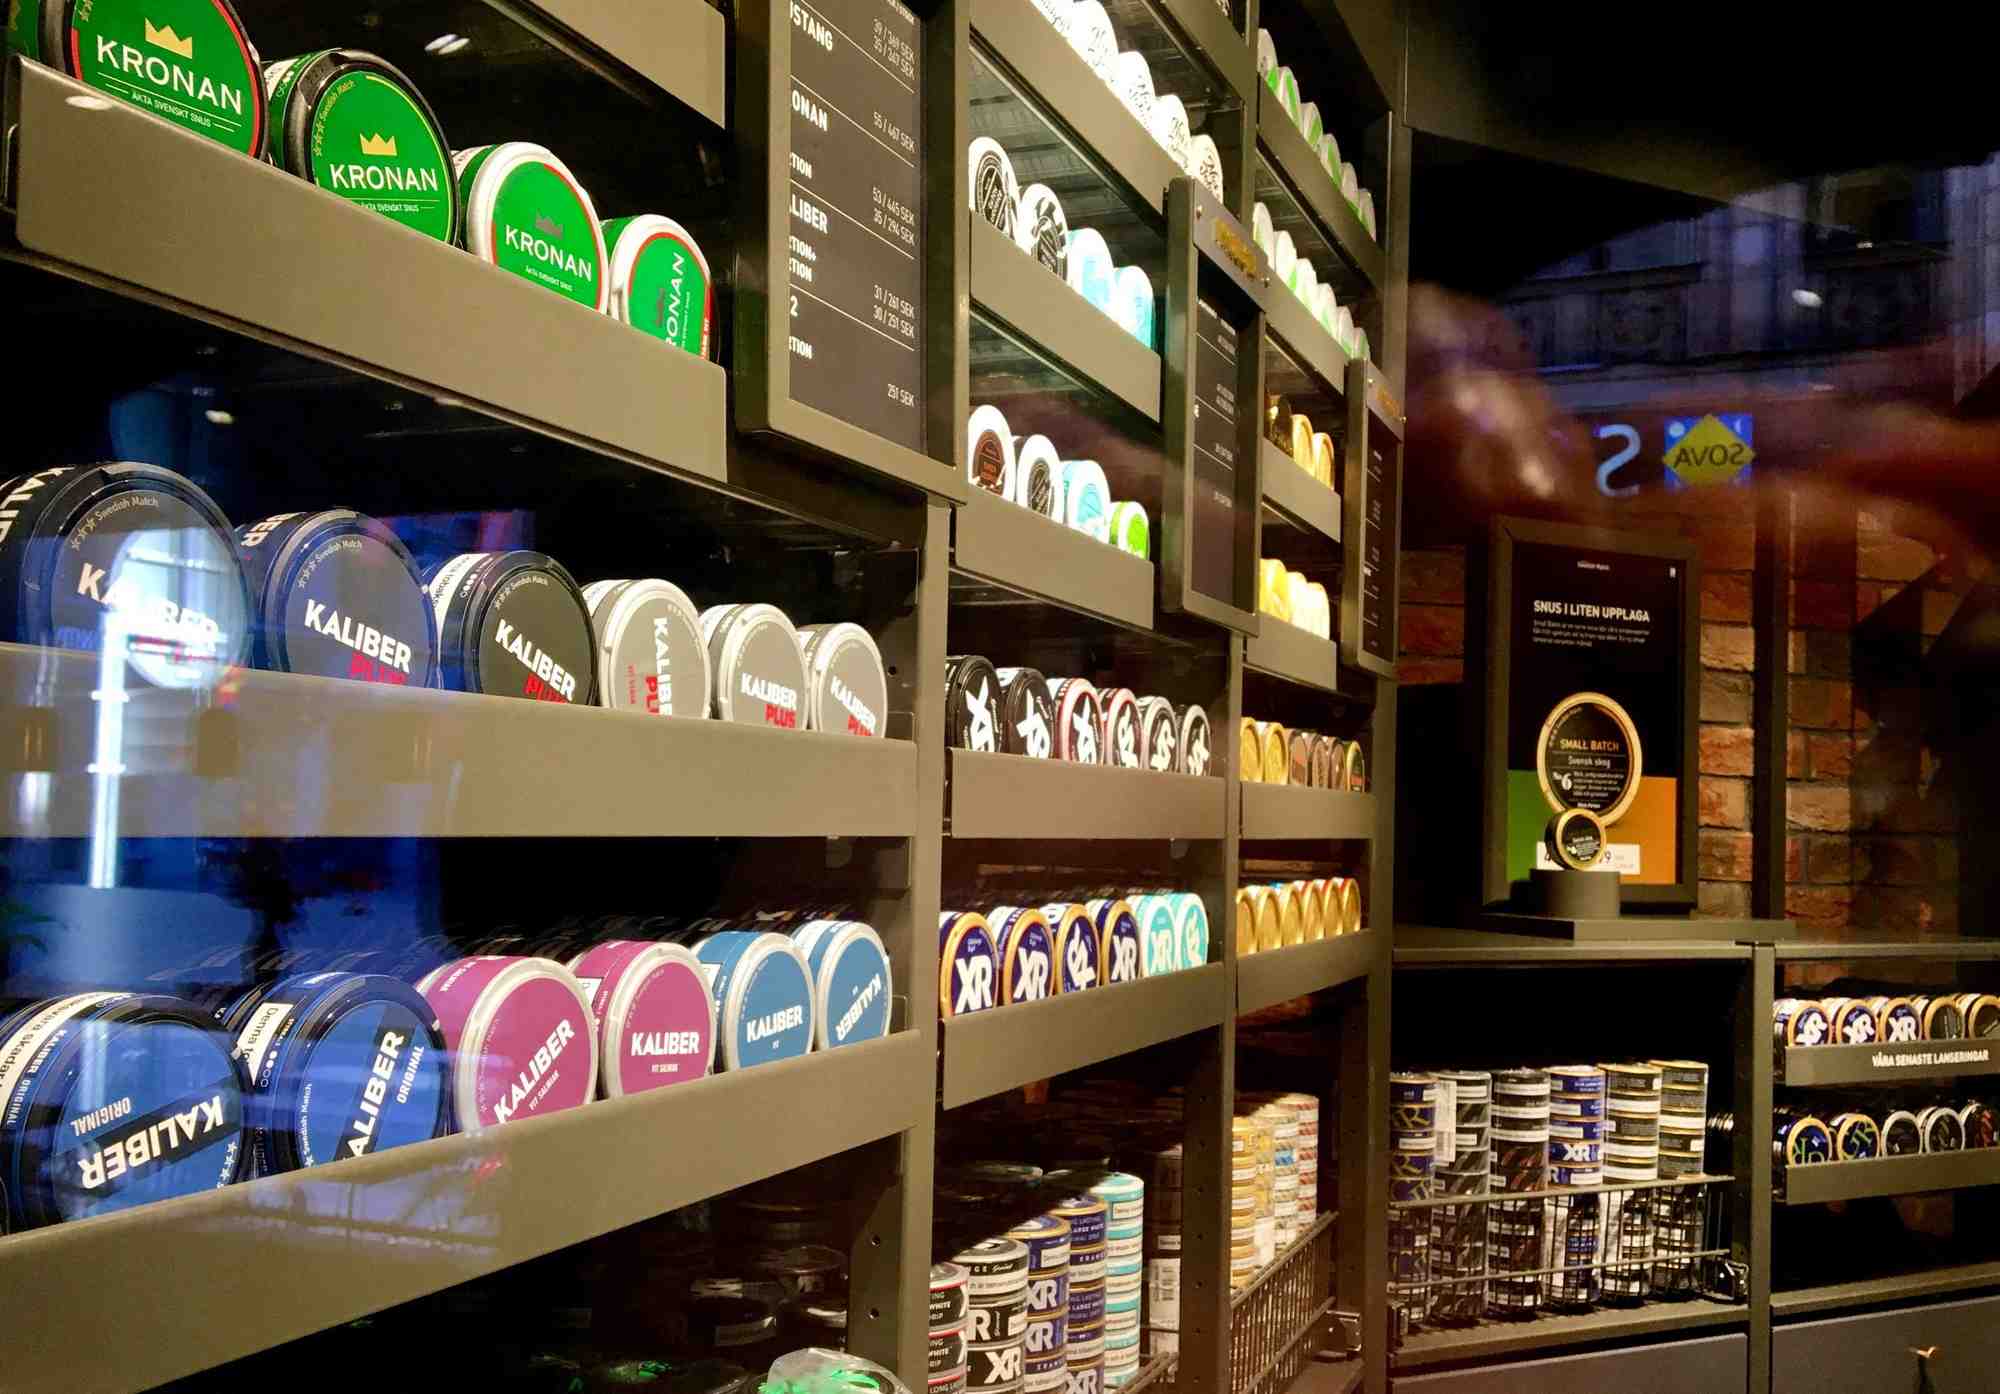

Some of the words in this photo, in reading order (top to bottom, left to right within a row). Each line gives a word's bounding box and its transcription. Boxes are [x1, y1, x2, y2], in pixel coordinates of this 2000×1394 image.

[790, 1, 833, 51] STANG
[97, 35, 242, 115] KRONAN
[154, 99, 189, 120] SVENSKT
[190, 111, 212, 128] SNUS
[330, 163, 439, 192] KRONAN
[789, 152, 812, 179] TION
[790, 194, 828, 234] LIBER
[505, 224, 592, 282] KRONAN
[789, 258, 812, 282] TION
[789, 336, 812, 359] TION
[1534, 600, 1562, 614] SNUS
[1570, 603, 1600, 618] LITEN
[1602, 606, 1650, 623] UPPLAGA
[304, 598, 412, 674] KALIBER
[495, 619, 576, 701] KALIBER
[741, 672, 797, 710] KALIBER
[830, 676, 877, 732] KALIBER
[764, 703, 796, 729] PLUS
[1560, 739, 1589, 750] SMALL
[1591, 740, 1619, 752] BATCH
[1013, 947, 1049, 1001] XR
[1111, 935, 1137, 982] XR
[955, 955, 992, 1013] XR
[746, 1005, 803, 1042] KALIBER
[835, 973, 882, 1041] KALIBER
[631, 1031, 701, 1056] KALIBER
[1888, 1016, 1917, 1041] XR
[28, 1029, 67, 1073] KALIBER
[493, 1019, 576, 1123] KALIBER
[1895, 1053, 1933, 1066] SENASTE
[348, 1031, 405, 1156] ALIBER
[396, 1046, 425, 1104] ORIGINAL
[7, 1079, 31, 1125] ORIGINAL
[70, 1097, 131, 1137] ORIGINAL
[78, 1096, 223, 1189] KALIBER
[1027, 1279, 1058, 1311] XR
[984, 1347, 1021, 1384] XR
